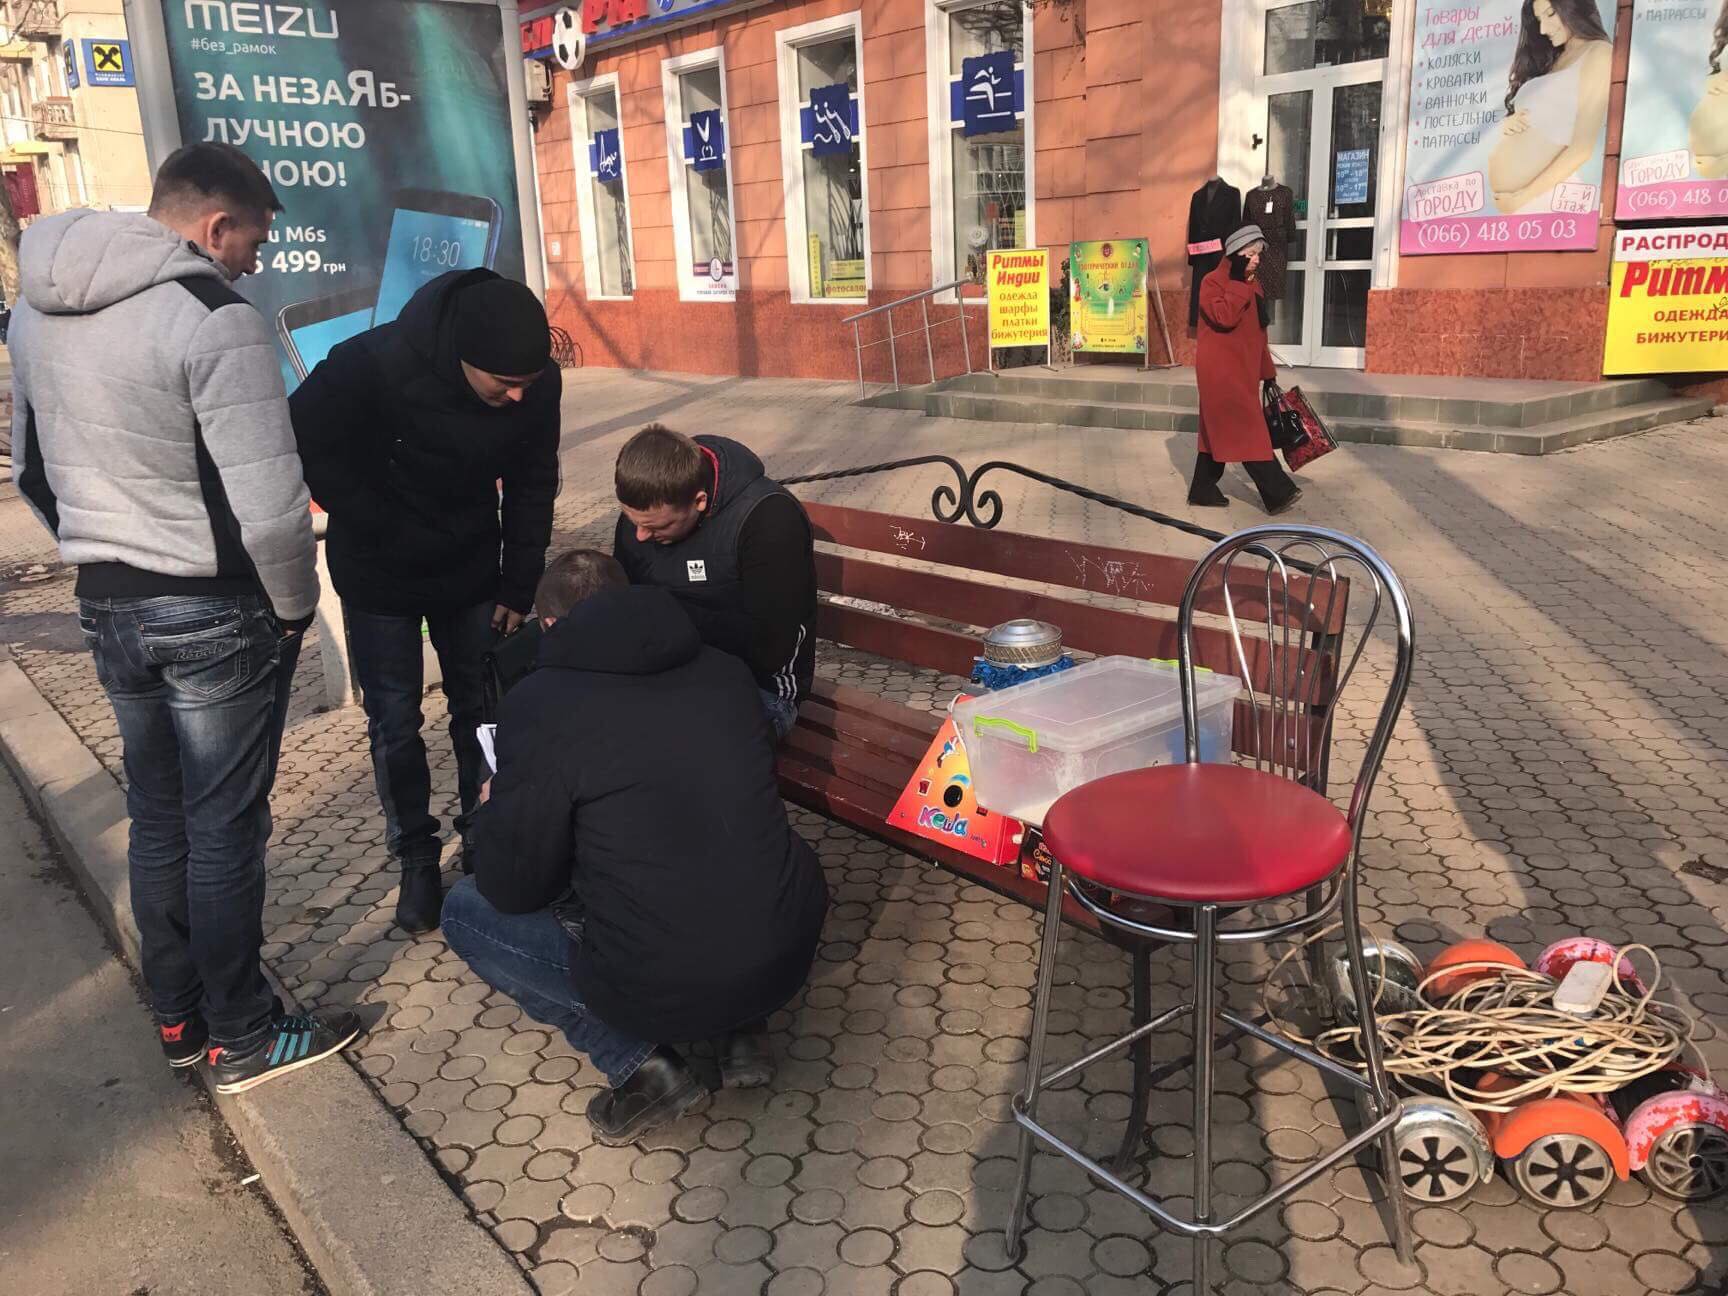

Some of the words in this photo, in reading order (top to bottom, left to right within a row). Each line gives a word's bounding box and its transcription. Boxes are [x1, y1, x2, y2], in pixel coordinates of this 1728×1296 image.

[184, 0, 339, 39] MEIZU
[1425, 7, 1480, 27] Товары
[1646, 8, 1707, 22] МАТРАССЫ
[1421, 30, 1456, 49] для
[1461, 16, 1519, 43] детей:
[190, 38, 277, 55] #без_рамок
[1427, 51, 1481, 70] КОЛЯСКИ
[194, 71, 245, 101] ЗА
[252, 69, 412, 108] НЕЗАЯБ-
[1426, 70, 1484, 90] КРОВАТКИ
[1425, 91, 1488, 110] ВАННОЧКИ
[1424, 109, 1500, 130] ПОСТЕЛЬНОЕ
[202, 117, 366, 149] ЛУЧНОЮ
[1422, 131, 1481, 149] МАТРАССЫ
[1337, 150, 1369, 161] МАГАЗИН
[1630, 162, 1685, 185] ГОРОДУ
[1416, 190, 1478, 218] ГОРОДУ
[1628, 189, 1677, 212] (066)
[1683, 188, 1711, 205] 418
[285, 226, 327, 243] M6s
[1418, 222, 1470, 249] (066)
[1477, 221, 1511, 242] 418
[1518, 220, 1544, 240] 05
[1551, 219, 1577, 239] 03
[1621, 232, 1728, 252] РАСПРОД
[411, 236, 462, 268] 18:30
[992, 254, 1044, 269] Ритмы
[271, 250, 322, 274] 499
[323, 262, 346, 275] грн
[996, 270, 1040, 288] Индии
[999, 291, 1038, 301] одежда
[999, 301, 1038, 317] шарфы
[1653, 309, 1728, 323] ОДЕЖДА
[1002, 318, 1038, 328] платки
[991, 328, 1048, 341] бижутерия
[1636, 330, 1728, 344] БИЖУТЕРИ
